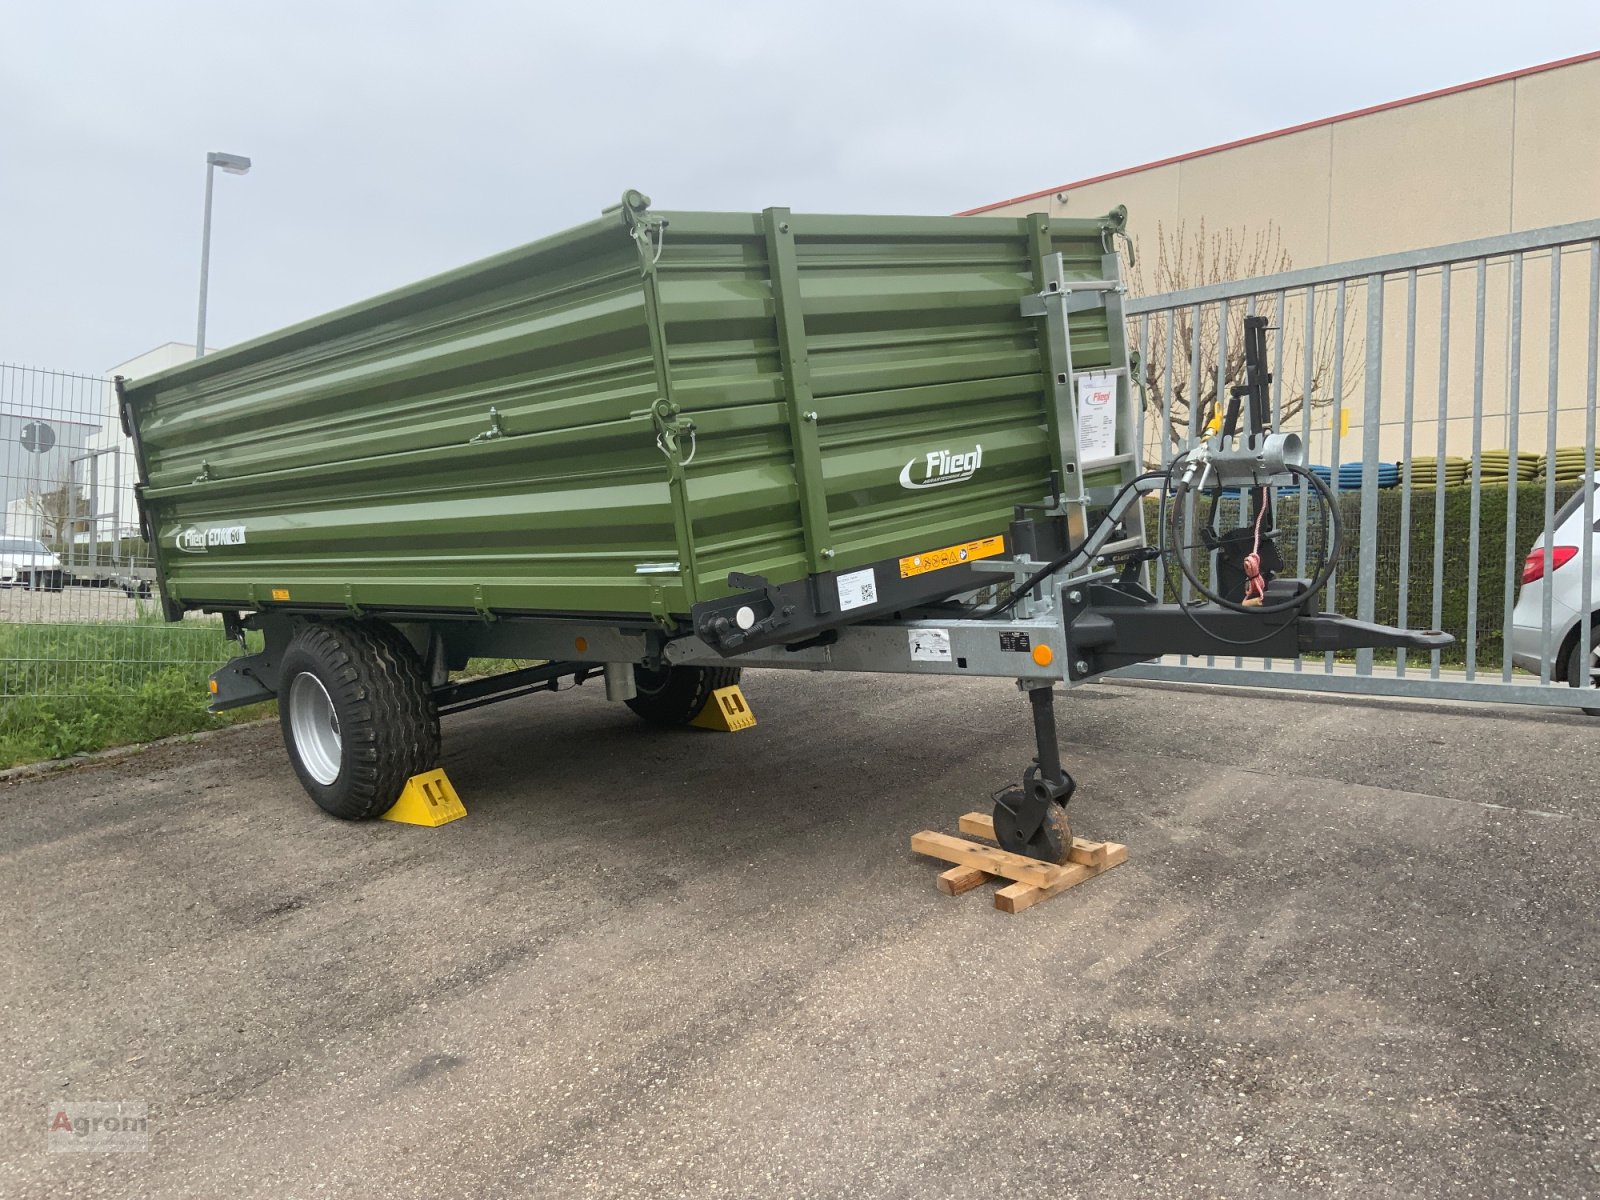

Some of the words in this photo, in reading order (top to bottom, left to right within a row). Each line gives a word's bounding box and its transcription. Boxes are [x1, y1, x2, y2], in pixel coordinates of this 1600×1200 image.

[926, 444, 982, 478] Fliegl
[185, 529, 208, 548] Fliegl
[209, 528, 227, 546] EDK
[230, 529, 240, 543] 60
